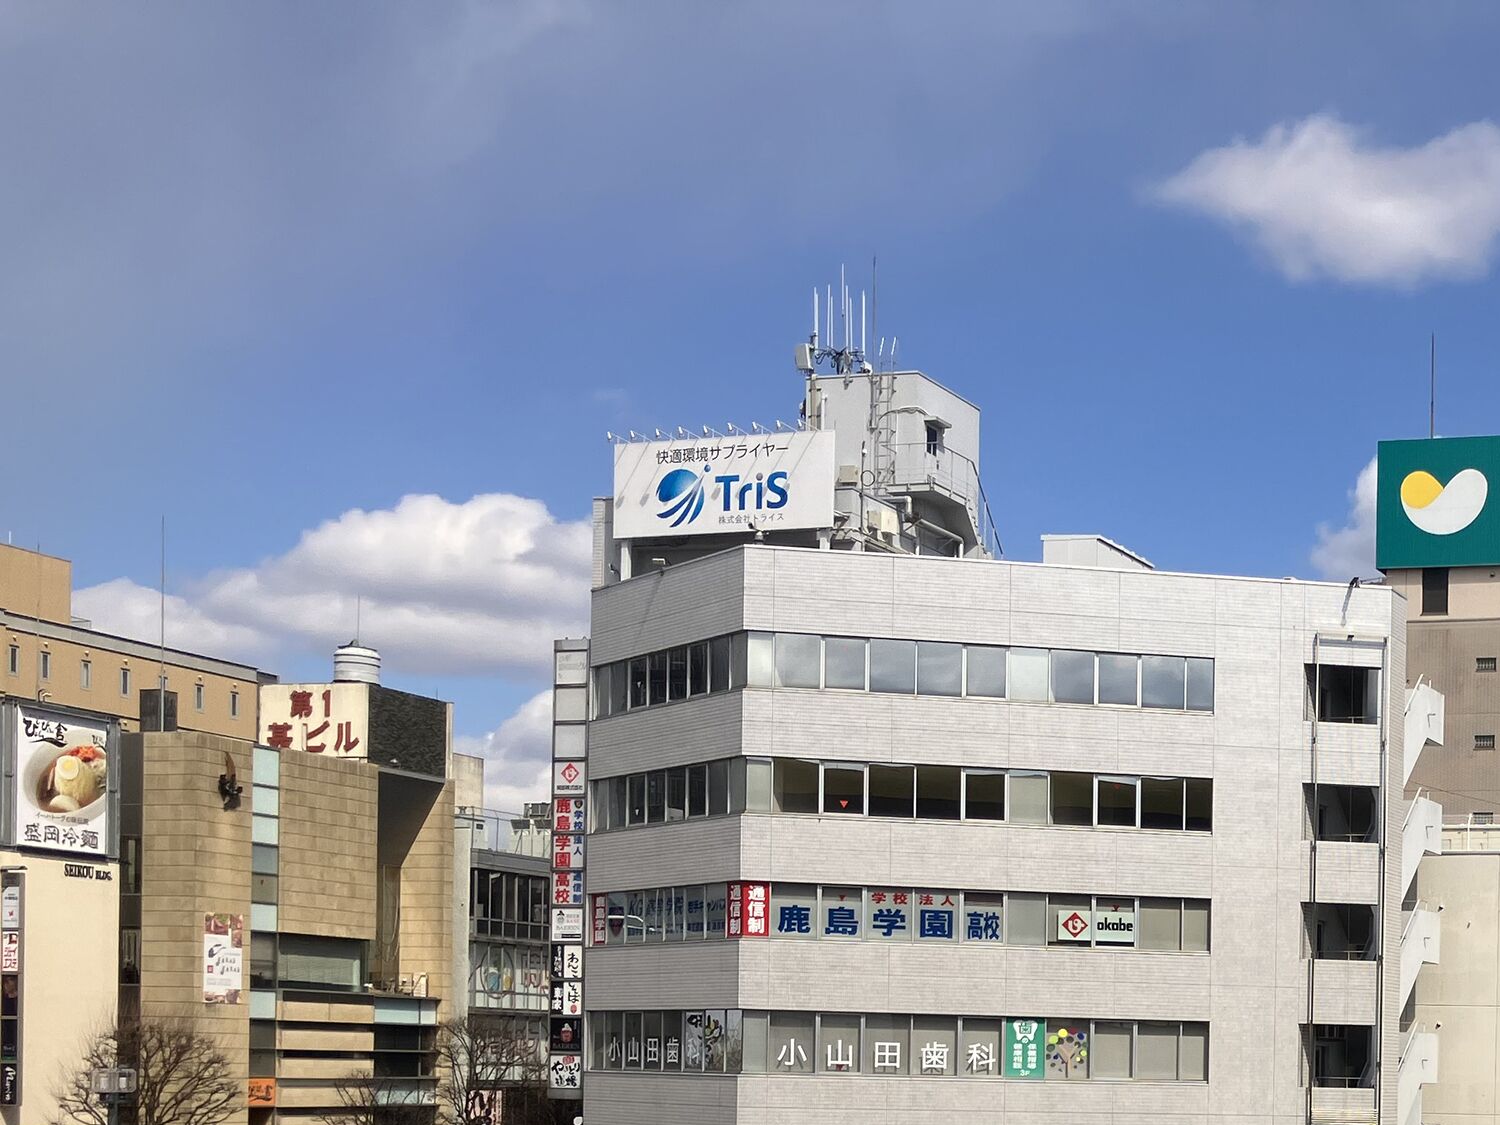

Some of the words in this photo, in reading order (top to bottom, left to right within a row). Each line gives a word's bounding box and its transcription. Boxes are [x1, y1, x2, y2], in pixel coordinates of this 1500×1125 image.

[656, 443, 789, 465] 快適環境サプライヤー
[715, 471, 789, 512] TriS
[718, 512, 785, 525] 株式会社トライス
[290, 689, 331, 719] 第1
[64, 863, 95, 880] SEIKOU
[747, 885, 766, 935] 通信制
[871, 892, 955, 907] 学校法人
[777, 904, 1001, 941] 鹿島学園高校
[1096, 919, 1134, 933] okabe
[777, 1037, 997, 1071] 小山田歯科
